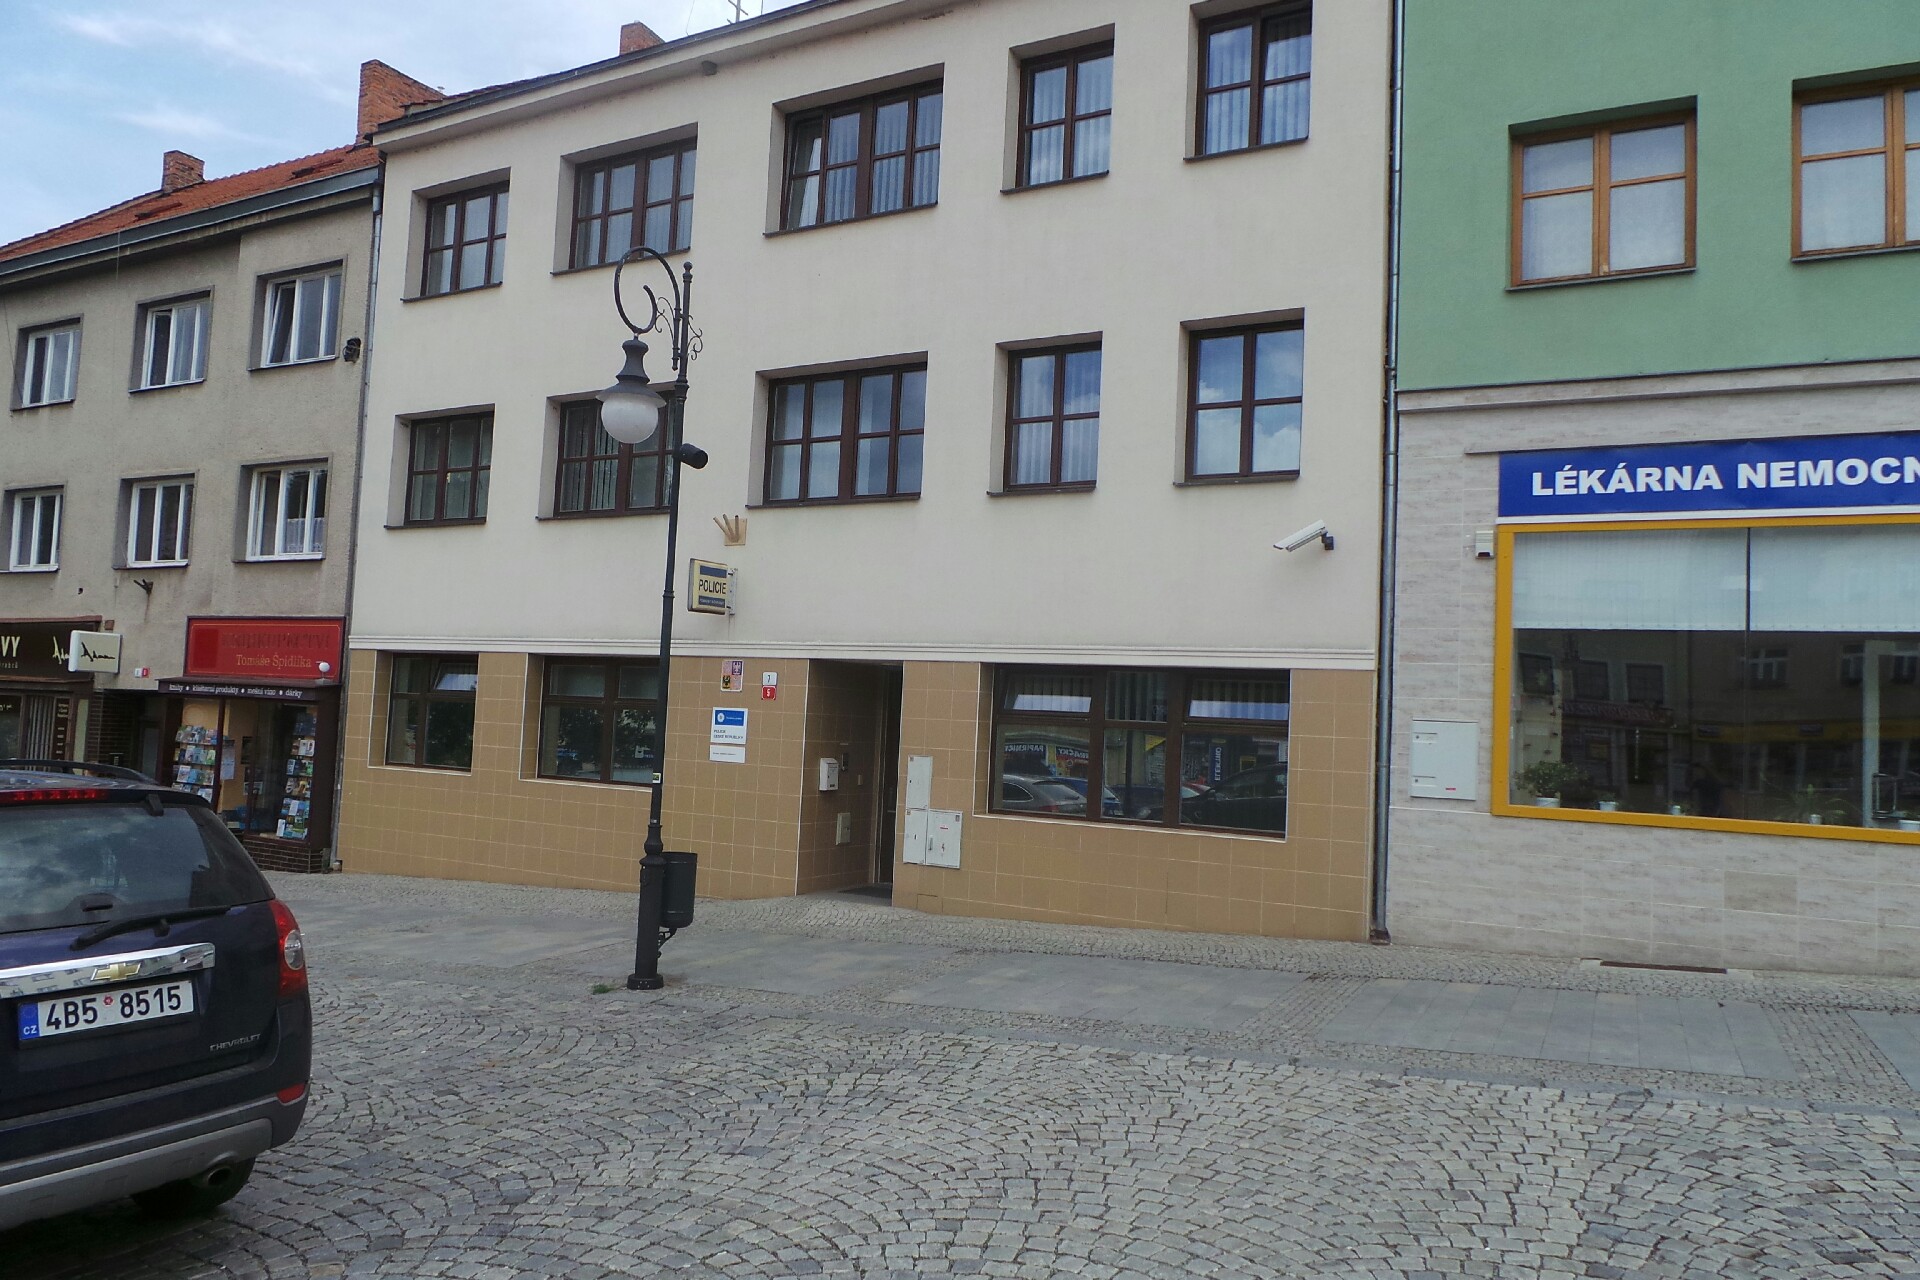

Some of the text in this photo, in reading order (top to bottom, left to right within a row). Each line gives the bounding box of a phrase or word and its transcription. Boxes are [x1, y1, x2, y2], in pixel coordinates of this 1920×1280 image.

[1532, 456, 1920, 496] LÉKÁRNA NEMOCN
[698, 579, 727, 595] POLICIE
[236, 653, 270, 667] Tomáše
[215, 686, 239, 695] produkty
[286, 687, 303, 698] dárky
[46, 985, 182, 1030] 4B5 8515
[23, 1025, 37, 1035] CZ
[209, 1033, 262, 1052] CHEVROLET
